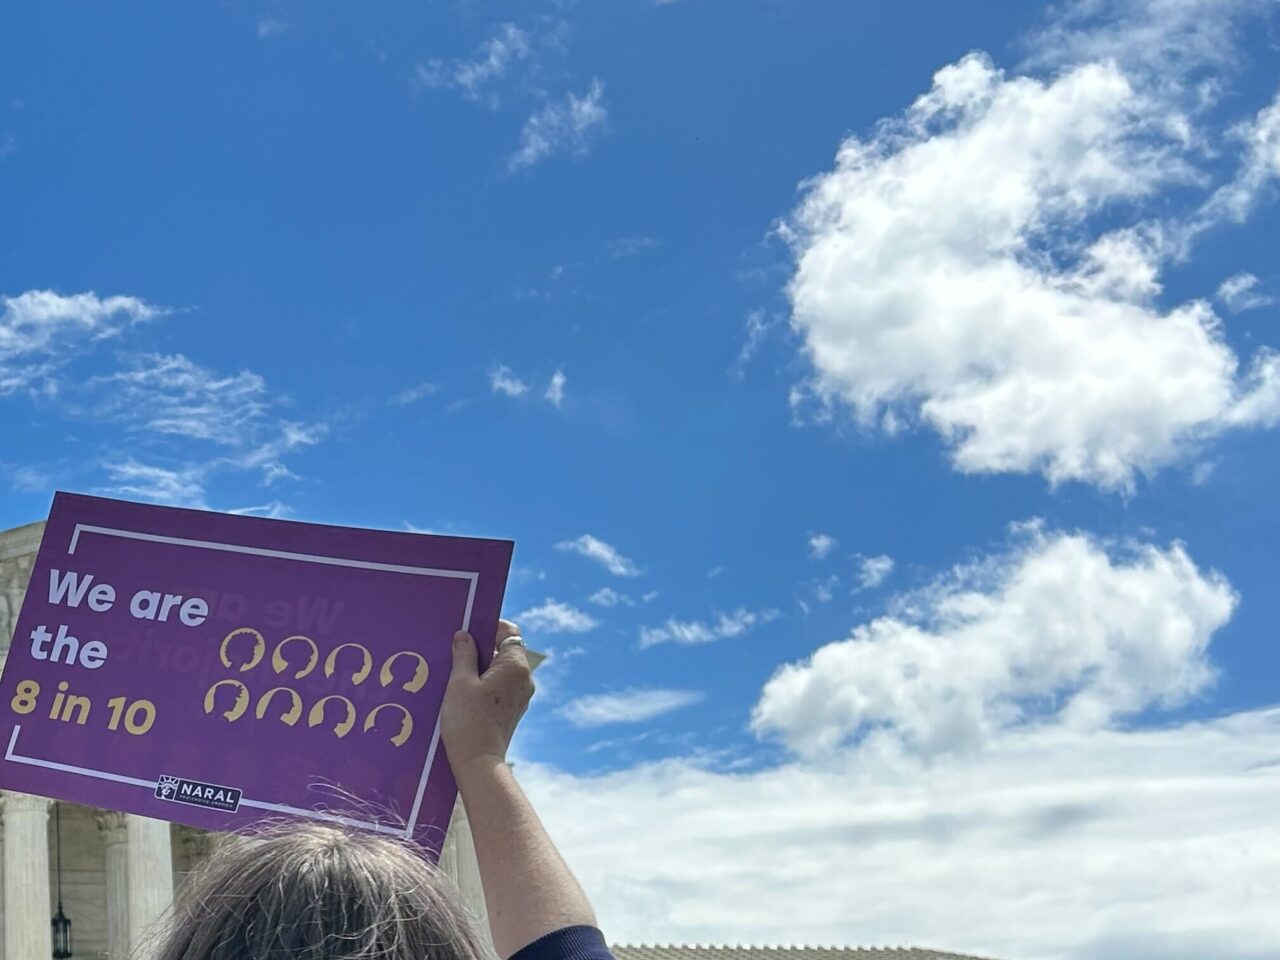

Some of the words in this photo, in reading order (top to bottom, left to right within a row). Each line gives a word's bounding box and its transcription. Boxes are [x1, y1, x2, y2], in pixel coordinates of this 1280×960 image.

[48, 568, 116, 612] We
[130, 590, 209, 627] are
[30, 625, 108, 669] the
[11, 680, 40, 714] 8
[49, 681, 91, 725] in
[107, 697, 156, 735] 10
[181, 783, 235, 803] NARAL
